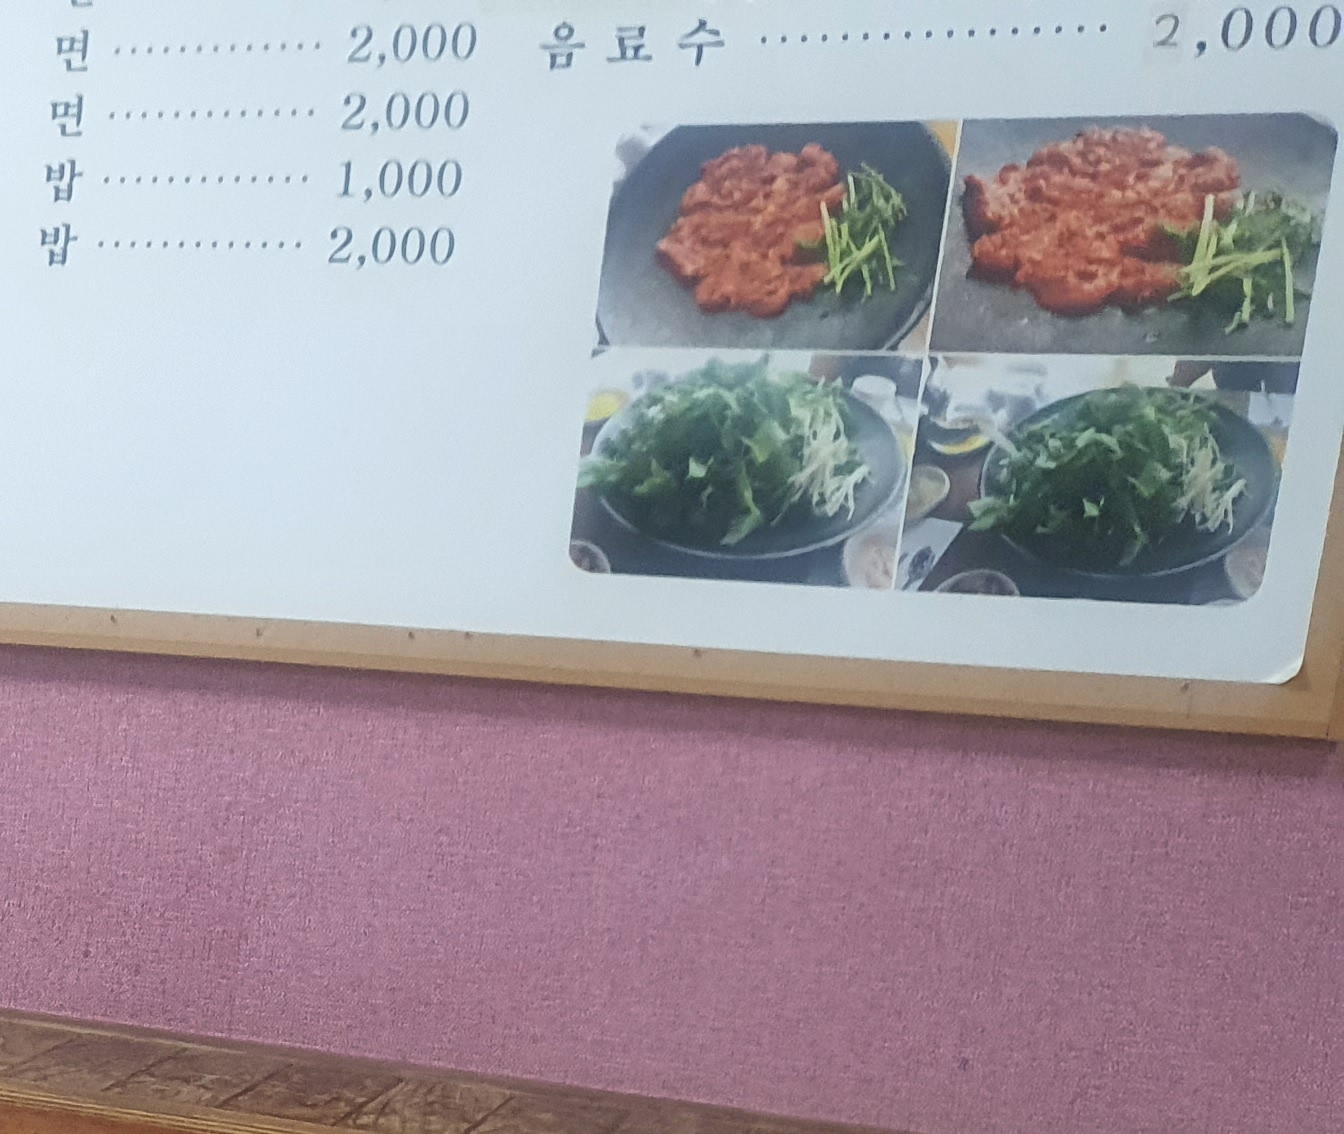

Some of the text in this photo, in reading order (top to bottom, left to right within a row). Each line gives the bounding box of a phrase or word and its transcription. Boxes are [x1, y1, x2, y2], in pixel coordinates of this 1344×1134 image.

[347, 22, 477, 68] 2,000
[1153, 4, 1342, 58] 2,000
[342, 90, 470, 135] 2,000
[337, 159, 462, 203] 1,000
[328, 226, 455, 270] 2,000
